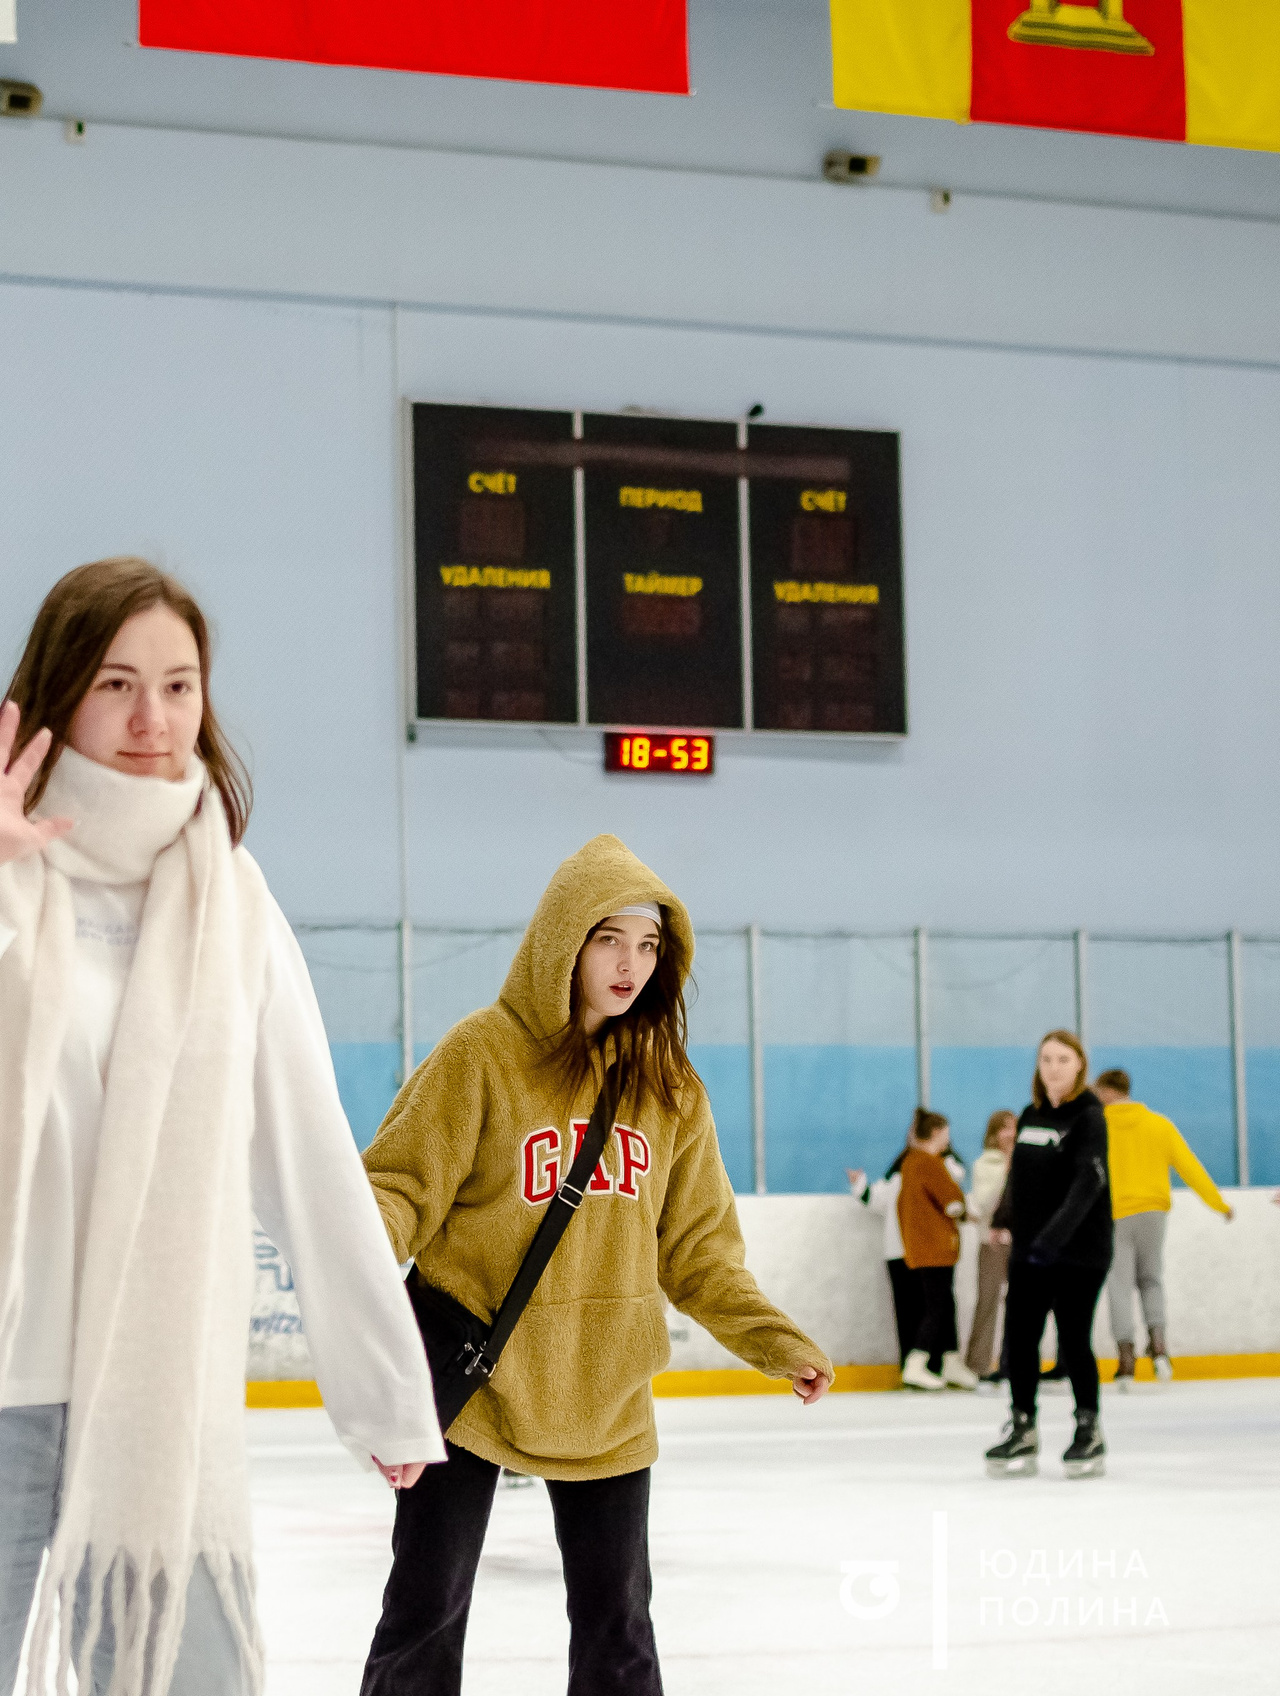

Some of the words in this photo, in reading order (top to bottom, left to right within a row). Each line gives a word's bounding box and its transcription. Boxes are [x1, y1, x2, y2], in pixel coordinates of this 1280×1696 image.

[619, 486, 703, 513] ПЕРИОД
[440, 565, 551, 589] УДАЛЕНИЯ
[623, 570, 703, 597] ТАЙМЕР
[773, 580, 879, 605] УДАЛЕНИЯ
[621, 736, 709, 770] 18-53
[520, 1118, 652, 1207] GAP
